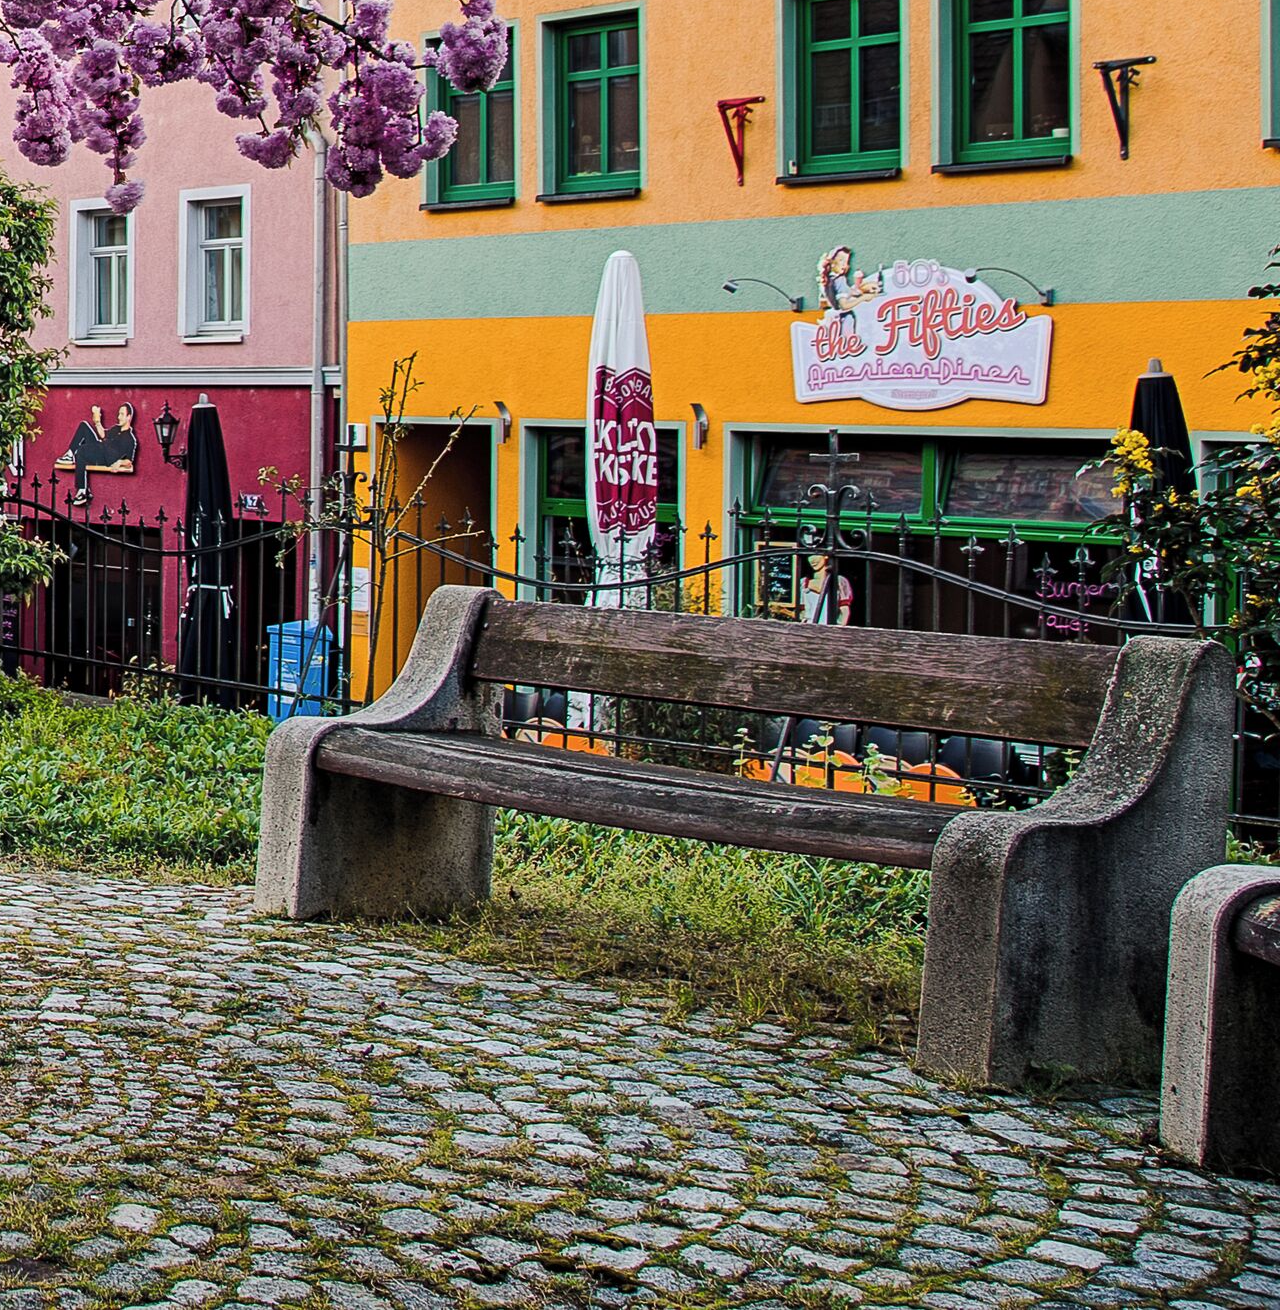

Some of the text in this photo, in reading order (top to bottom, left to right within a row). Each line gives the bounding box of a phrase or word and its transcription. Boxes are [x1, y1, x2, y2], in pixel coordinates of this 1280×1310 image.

[811, 289, 1026, 361] the Fifties
[808, 357, 1030, 390] American Diner
